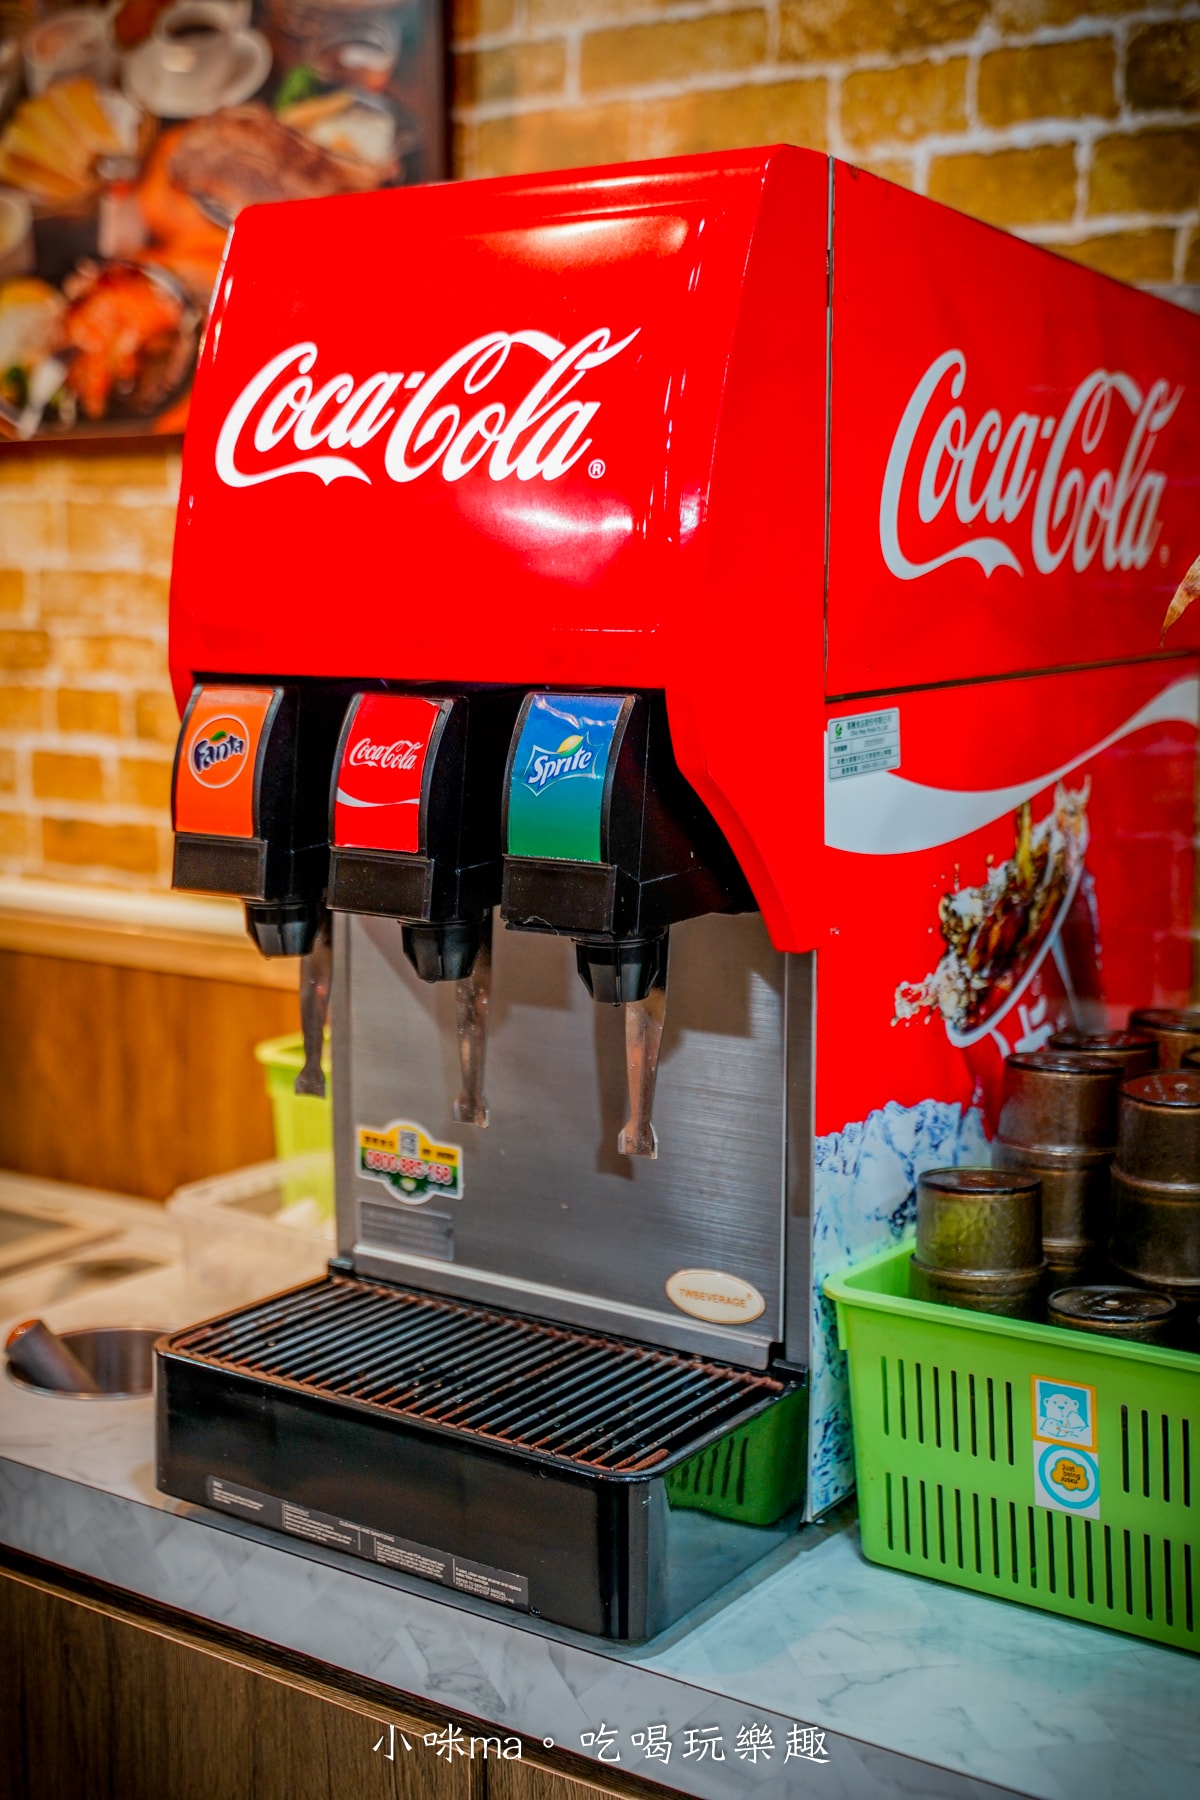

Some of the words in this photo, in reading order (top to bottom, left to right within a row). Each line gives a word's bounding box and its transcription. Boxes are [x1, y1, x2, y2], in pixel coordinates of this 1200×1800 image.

[215, 327, 642, 487] Coca-Cola
[879, 348, 1185, 580] Coca-Cola
[193, 734, 245, 774] Fanta
[349, 738, 424, 770] Coca-Cola
[527, 745, 593, 787] Sprite
